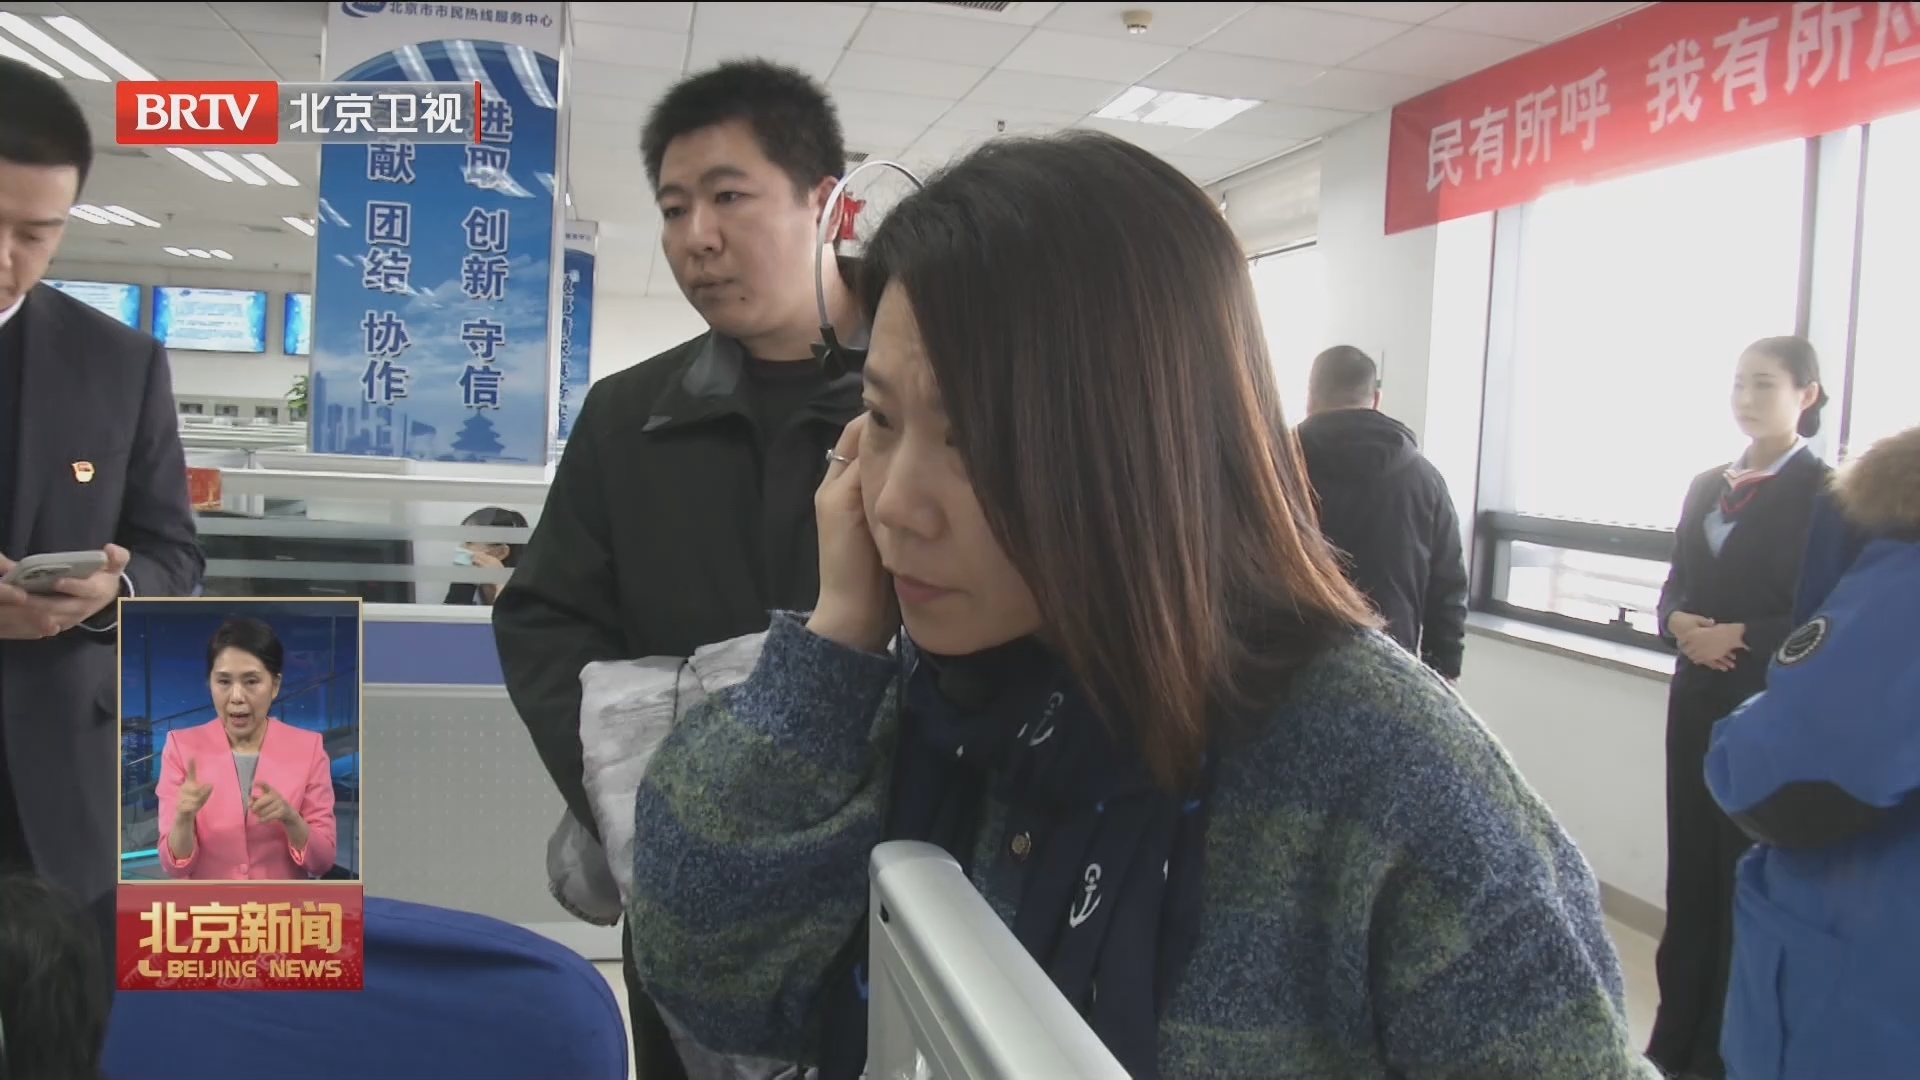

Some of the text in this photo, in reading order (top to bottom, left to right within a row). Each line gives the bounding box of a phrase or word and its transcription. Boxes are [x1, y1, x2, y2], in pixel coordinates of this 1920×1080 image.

[389, 2, 553, 27] 北京市市民热线服务中心
[1426, 67, 1611, 192] 民有所呼
[363, 201, 411, 290] 团结
[459, 99, 513, 408] 进取 创新 守信
[361, 310, 409, 401] 协作
